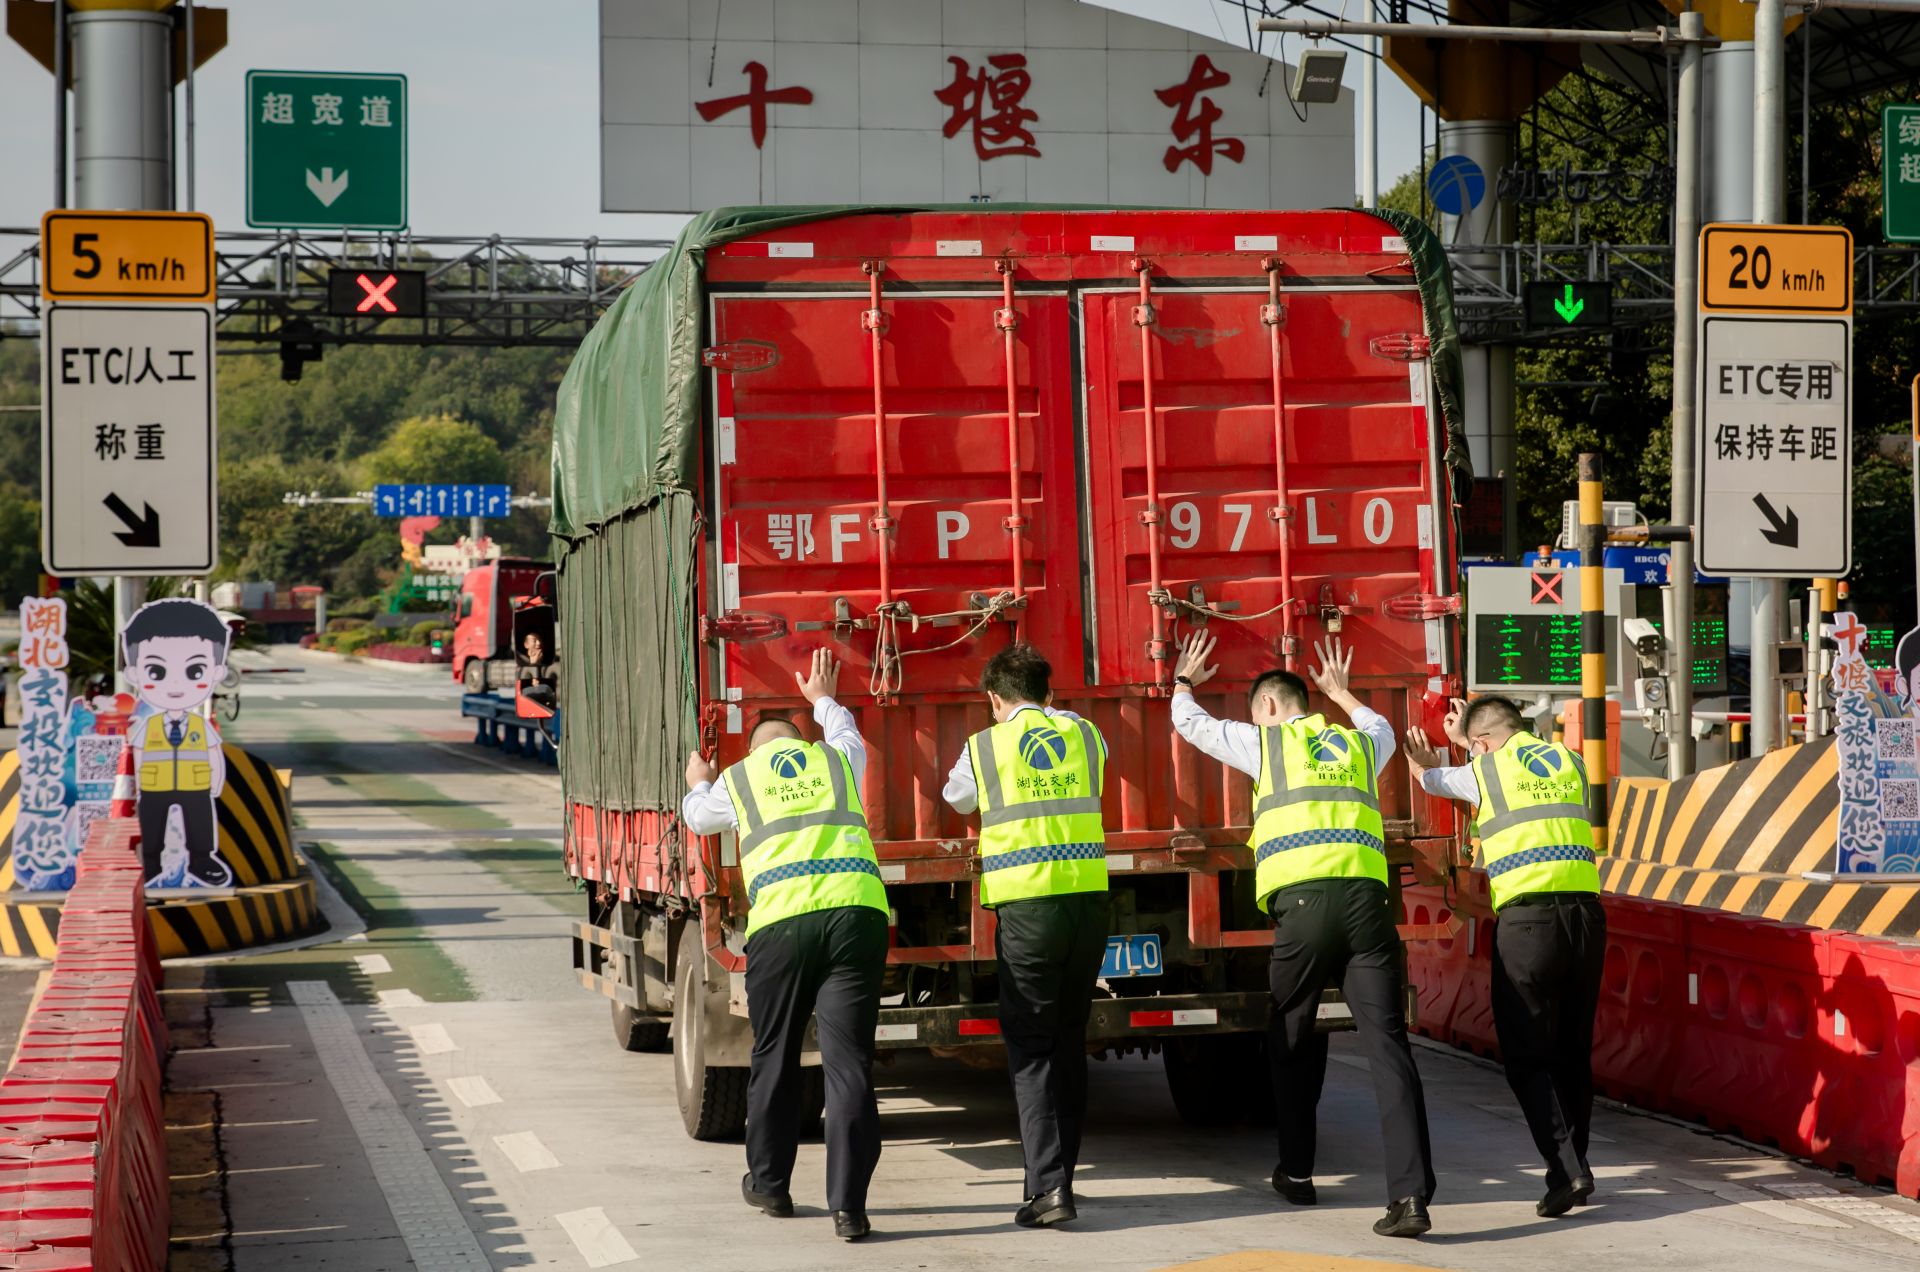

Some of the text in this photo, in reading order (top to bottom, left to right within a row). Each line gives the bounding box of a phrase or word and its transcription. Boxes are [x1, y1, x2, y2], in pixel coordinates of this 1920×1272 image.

[261, 92, 392, 127] 超宽道
[694, 53, 1246, 177] 十堰东
[72, 233, 185, 281] 5 km/h
[1728, 245, 1825, 291] 20 km/h
[61, 346, 196, 385] ETC/人工
[1719, 363, 1832, 400] ETC专用
[95, 423, 165, 460] 称重
[1714, 423, 1837, 461] 保持车距
[16, 603, 64, 872] 湖北交投欢迎您
[1834, 614, 1881, 851] 十堰文旅欢迎您
[765, 777, 825, 796] 湖北交投
[781, 791, 815, 802] HBCI
[1017, 772, 1080, 789] 湖北交投
[1032, 788, 1067, 797] HBCI
[1102, 941, 1159, 971] 7L0
